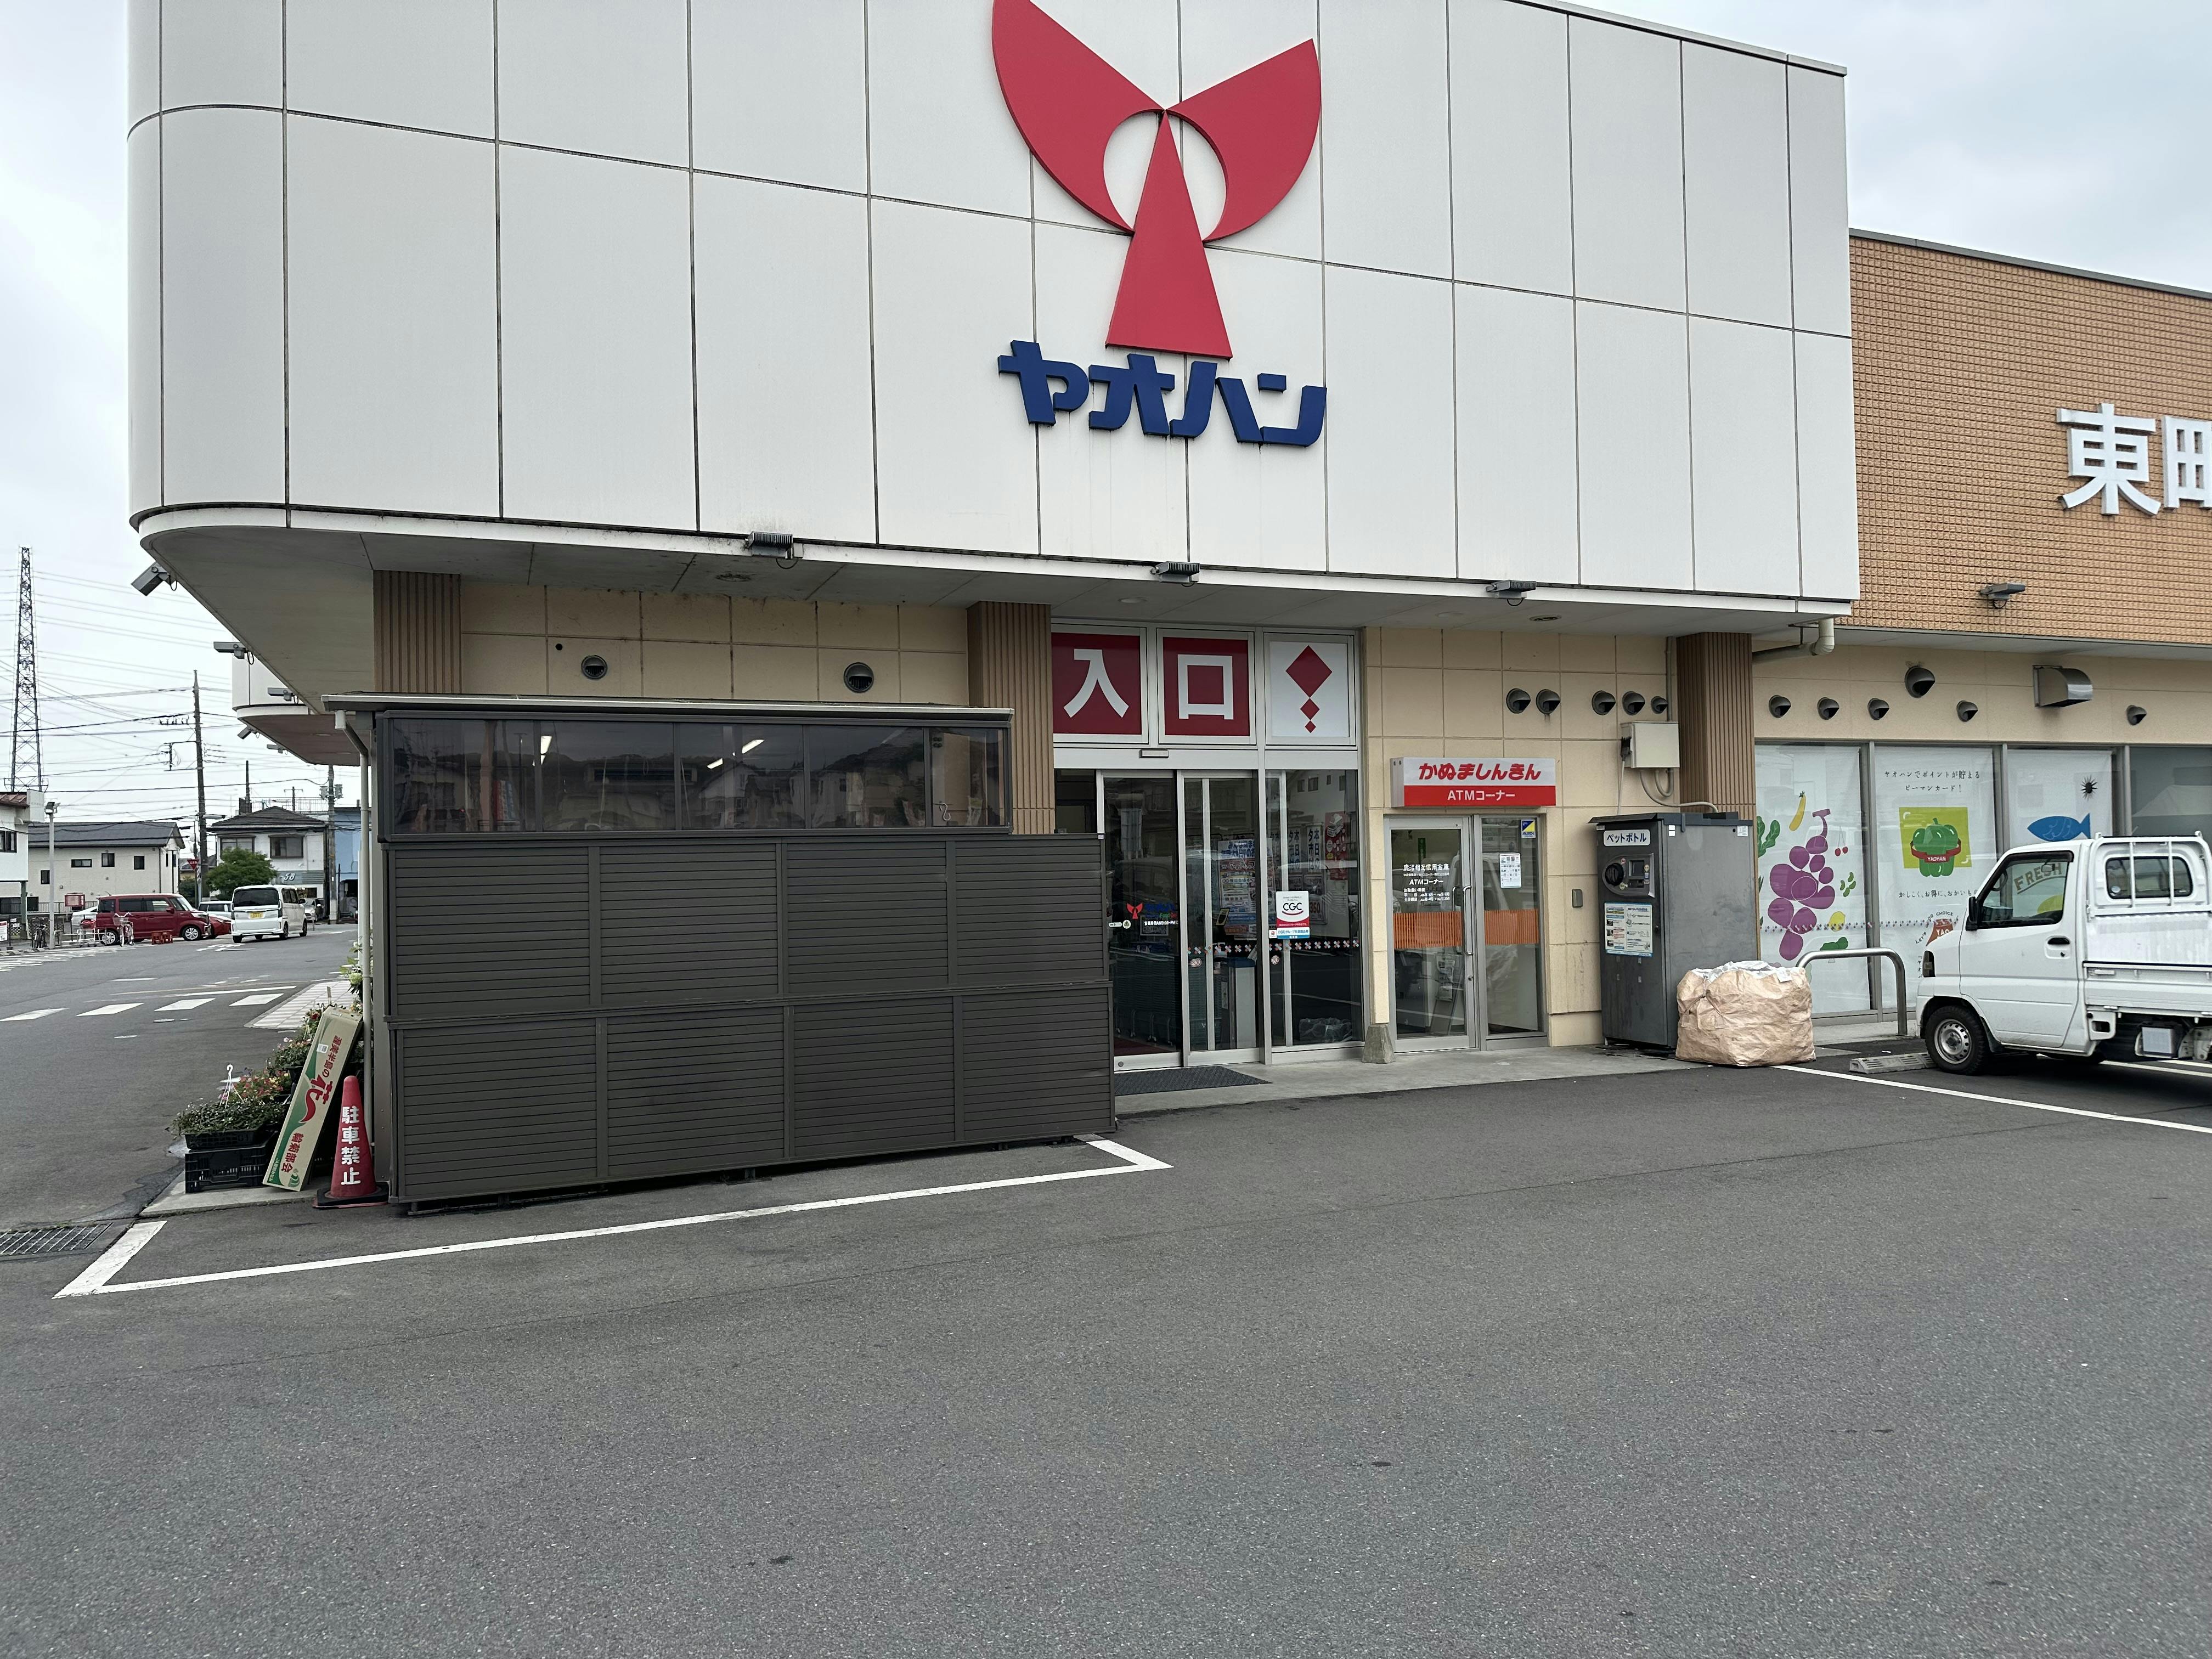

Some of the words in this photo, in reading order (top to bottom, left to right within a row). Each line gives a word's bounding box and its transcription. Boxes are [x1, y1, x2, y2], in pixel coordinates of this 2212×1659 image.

[998, 340, 1327, 447] ヤオハン
[1063, 648, 1234, 720] 入口
[1419, 763, 1541, 780] かぬましんきん
[1884, 770, 1980, 779] ヤオハンでポイントが貯まる
[1447, 790, 1515, 801] ATMコーナー
[1607, 833, 1647, 843] ペットボトル
[2013, 862, 2062, 890] FREH
[1283, 902, 1302, 911] CGC
[341, 1106, 361, 1185] 駐車禁止
